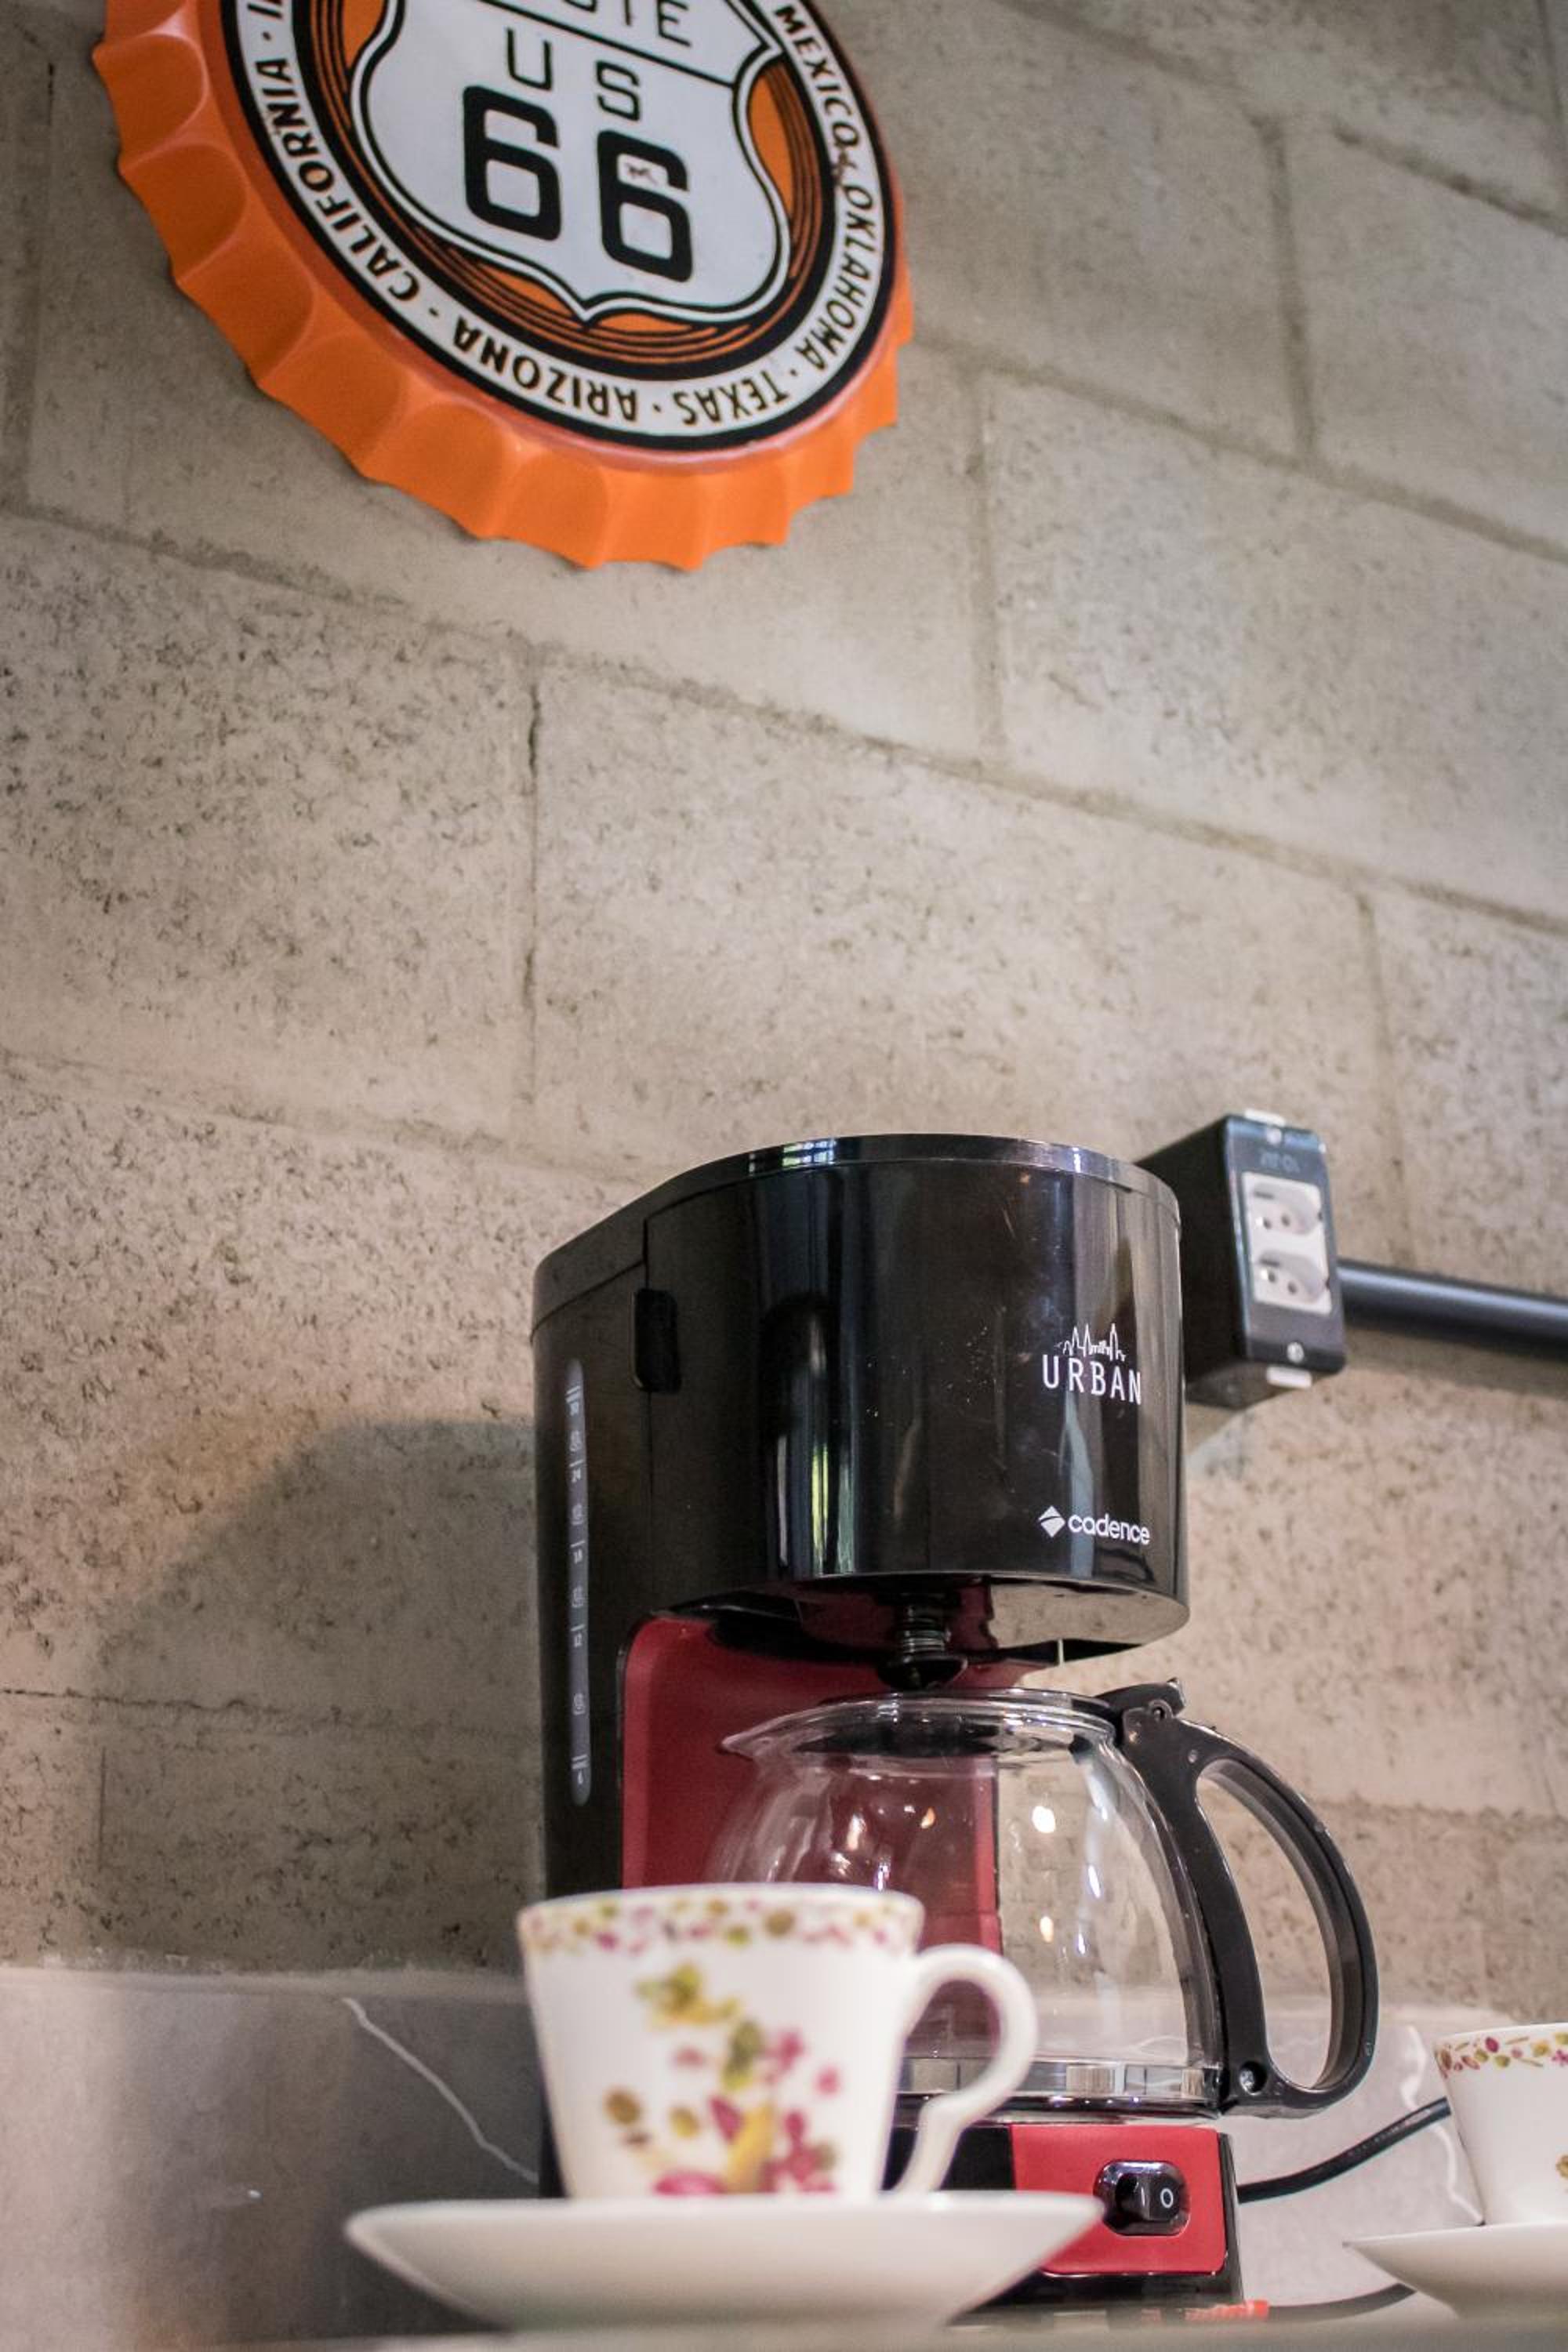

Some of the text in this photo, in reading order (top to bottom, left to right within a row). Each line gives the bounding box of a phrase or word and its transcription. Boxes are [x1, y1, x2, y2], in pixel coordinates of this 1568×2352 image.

[254, 5, 877, 425] MEXICO OKLAHOMA TEXAS ARIZONA CALIFORNIA
[463, 85, 694, 284] 66
[1042, 1354, 1142, 1405] URBAN
[1067, 1512, 1151, 1545] cadence
